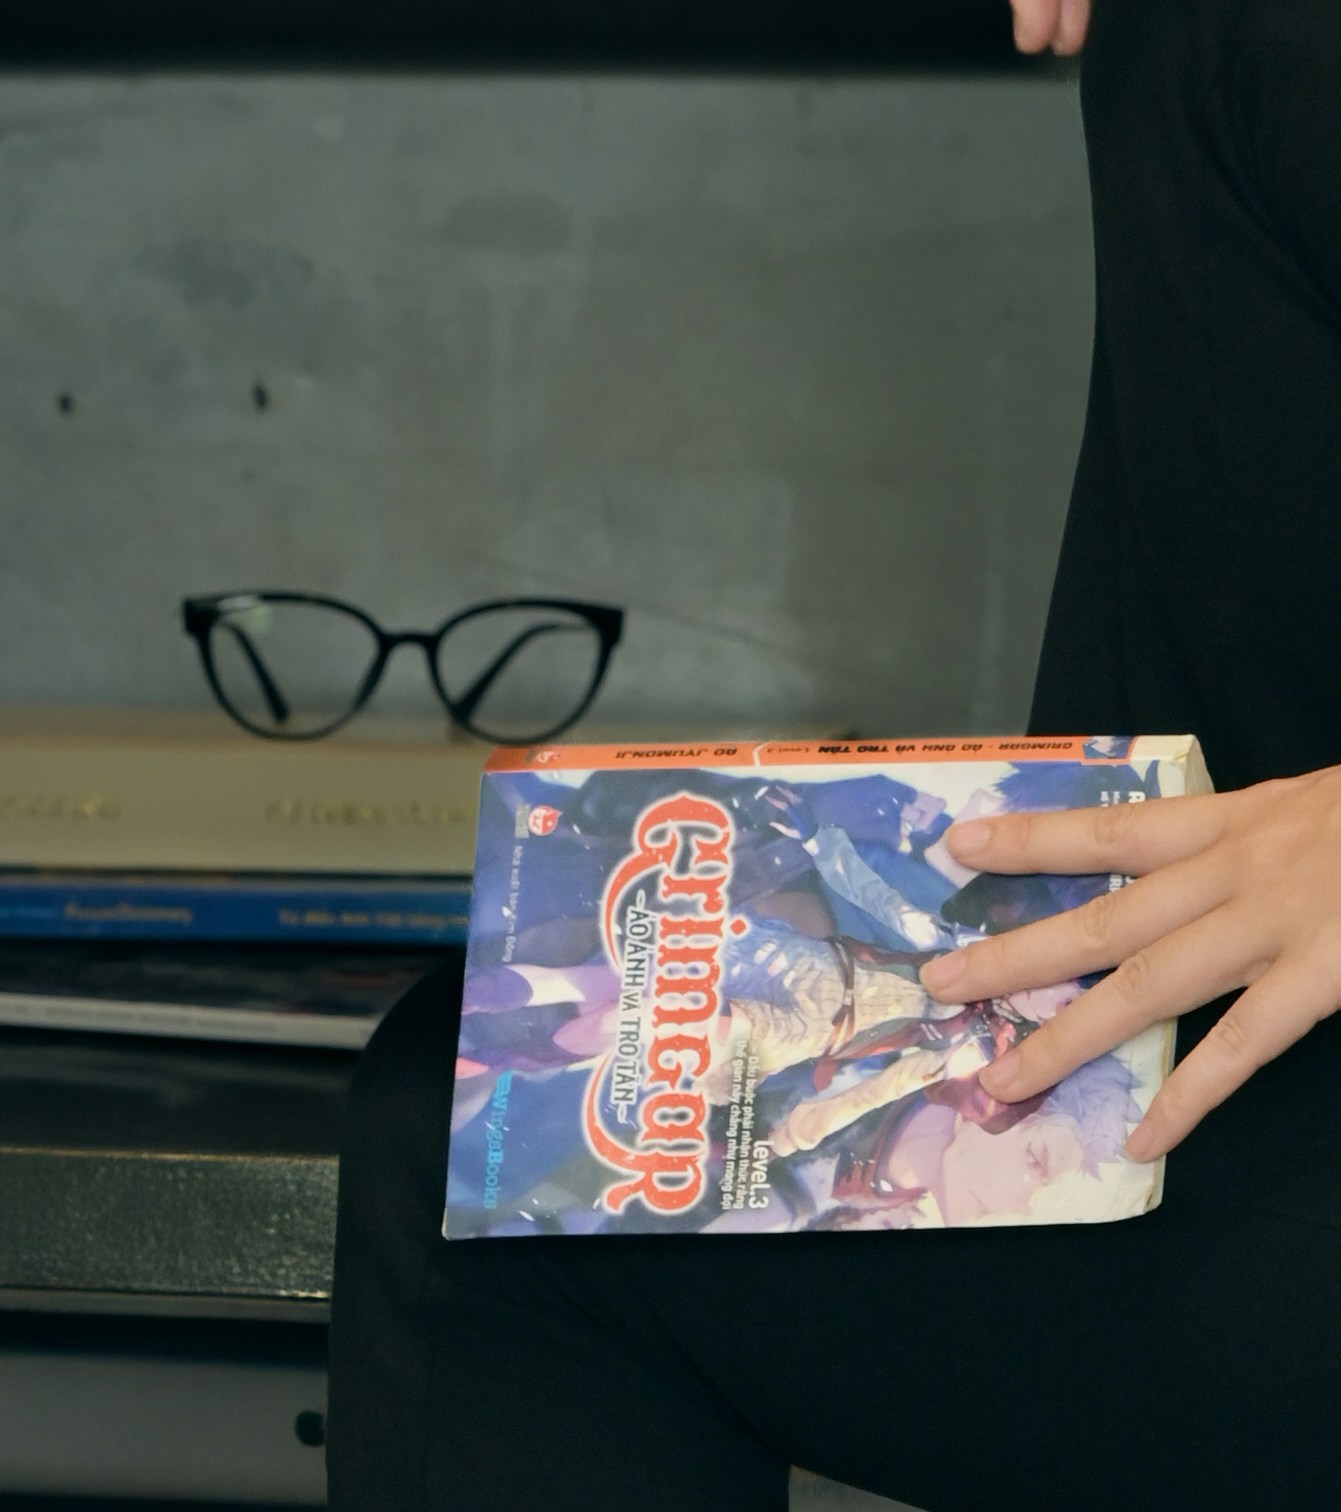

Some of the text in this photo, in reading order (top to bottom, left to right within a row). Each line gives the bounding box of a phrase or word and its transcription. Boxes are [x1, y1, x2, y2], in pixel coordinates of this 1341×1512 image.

[615, 748, 738, 759] AO JYUMONJI
[854, 745, 890, 753] TRO
[998, 742, 1074, 752] GRIMGAR
[512, 846, 523, 865] Nhà
[510, 868, 520, 889] xuất
[613, 909, 654, 1103] ẢO ẢNH VÀ TRO TÀN
[731, 1059, 744, 1082] gian
[728, 1084, 742, 1103] này
[743, 1079, 757, 1104] buộc
[726, 1104, 741, 1137] chẳng
[741, 1106, 754, 1128] phải
[484, 1093, 508, 1209] WingsBooks
[739, 1130, 753, 1157] nhận
[737, 1159, 751, 1182] thức
[749, 1140, 774, 1209] level.3
[721, 1193, 733, 1210] đợi
[733, 1184, 749, 1209] rằng
